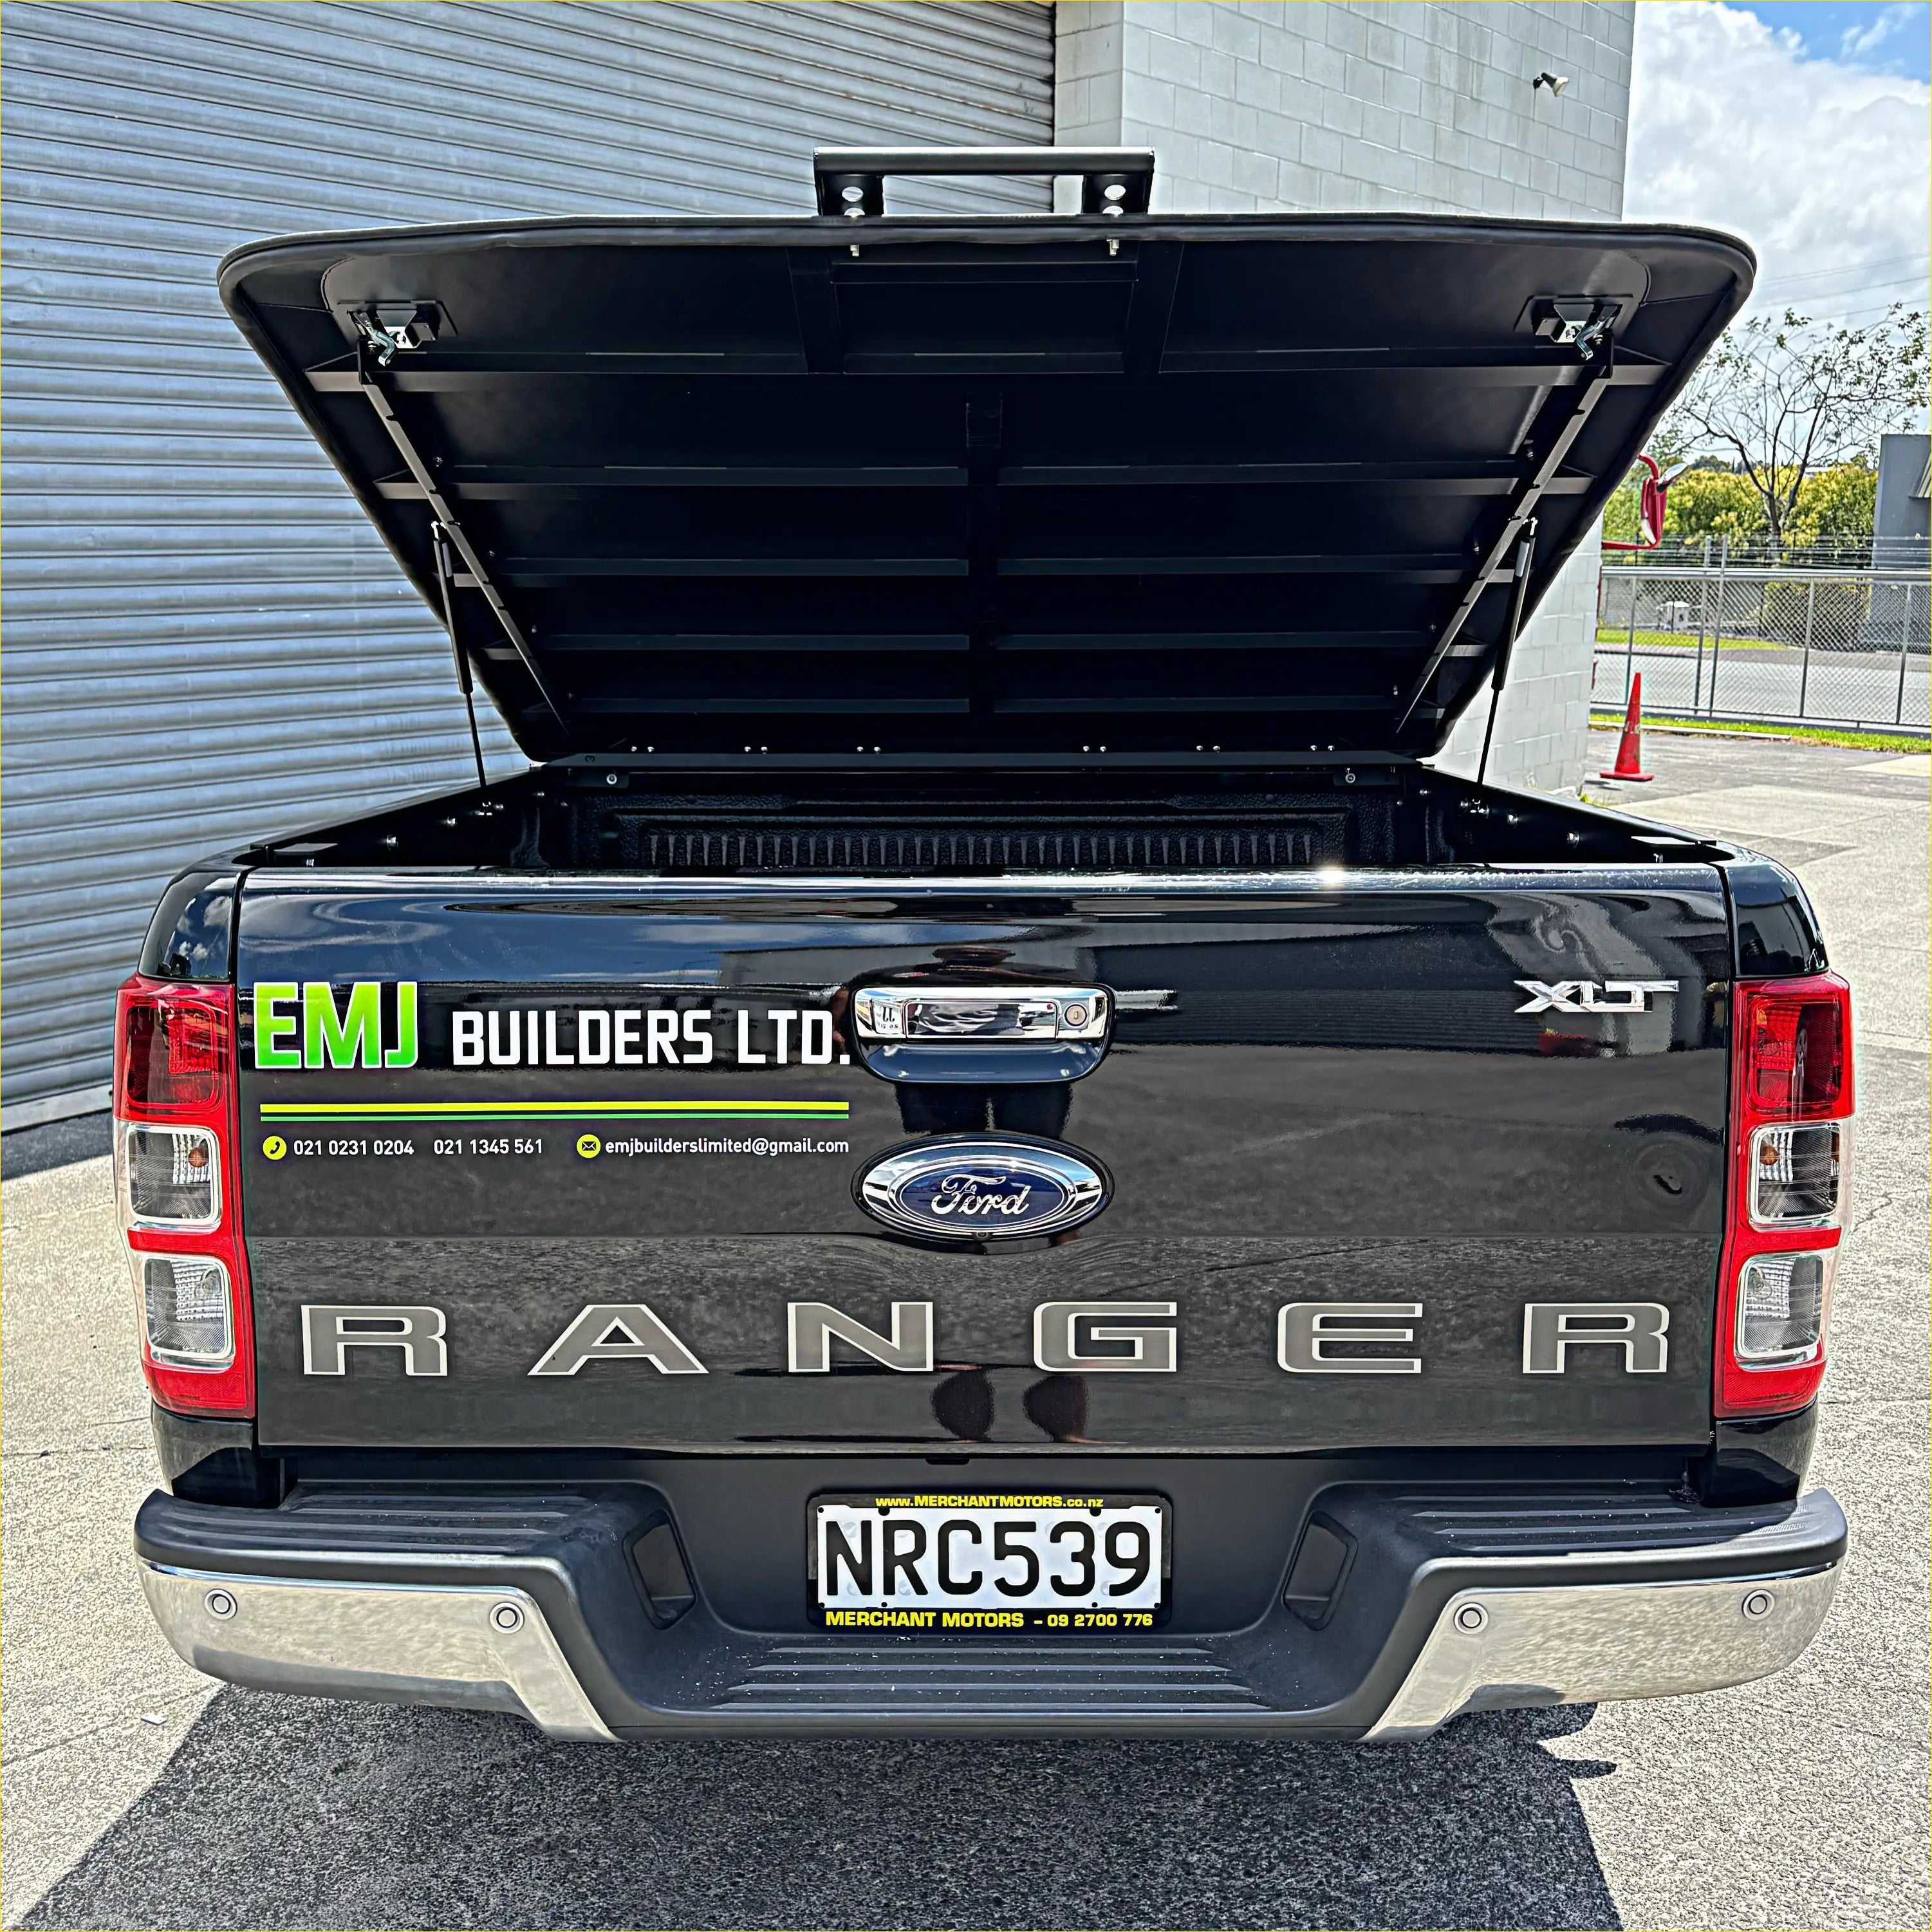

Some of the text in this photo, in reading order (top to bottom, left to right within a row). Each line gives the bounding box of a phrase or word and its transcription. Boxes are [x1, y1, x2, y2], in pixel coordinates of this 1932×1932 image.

[1514, 980, 1680, 1014] XLT
[253, 980, 850, 1069] EMJ BUILDERS LTD.
[293, 1138, 543, 1155] 021 0231 0204 021 1345 561
[605, 1137, 850, 1157] emjbuilderslimited@gmail.com
[931, 1174, 1031, 1216] Ford
[301, 1301, 1671, 1377] RANGER
[875, 1495, 1104, 1508] www.MERCHANTMOTORS.co.nz
[826, 1519, 1151, 1597] NRC539
[826, 1611, 935, 1626] MERCHANT
[942, 1612, 1025, 1628] MOTORS
[1047, 1614, 1069, 1627] 09
[1074, 1614, 1117, 1626] 2700
[1123, 1613, 1153, 1626] 776
